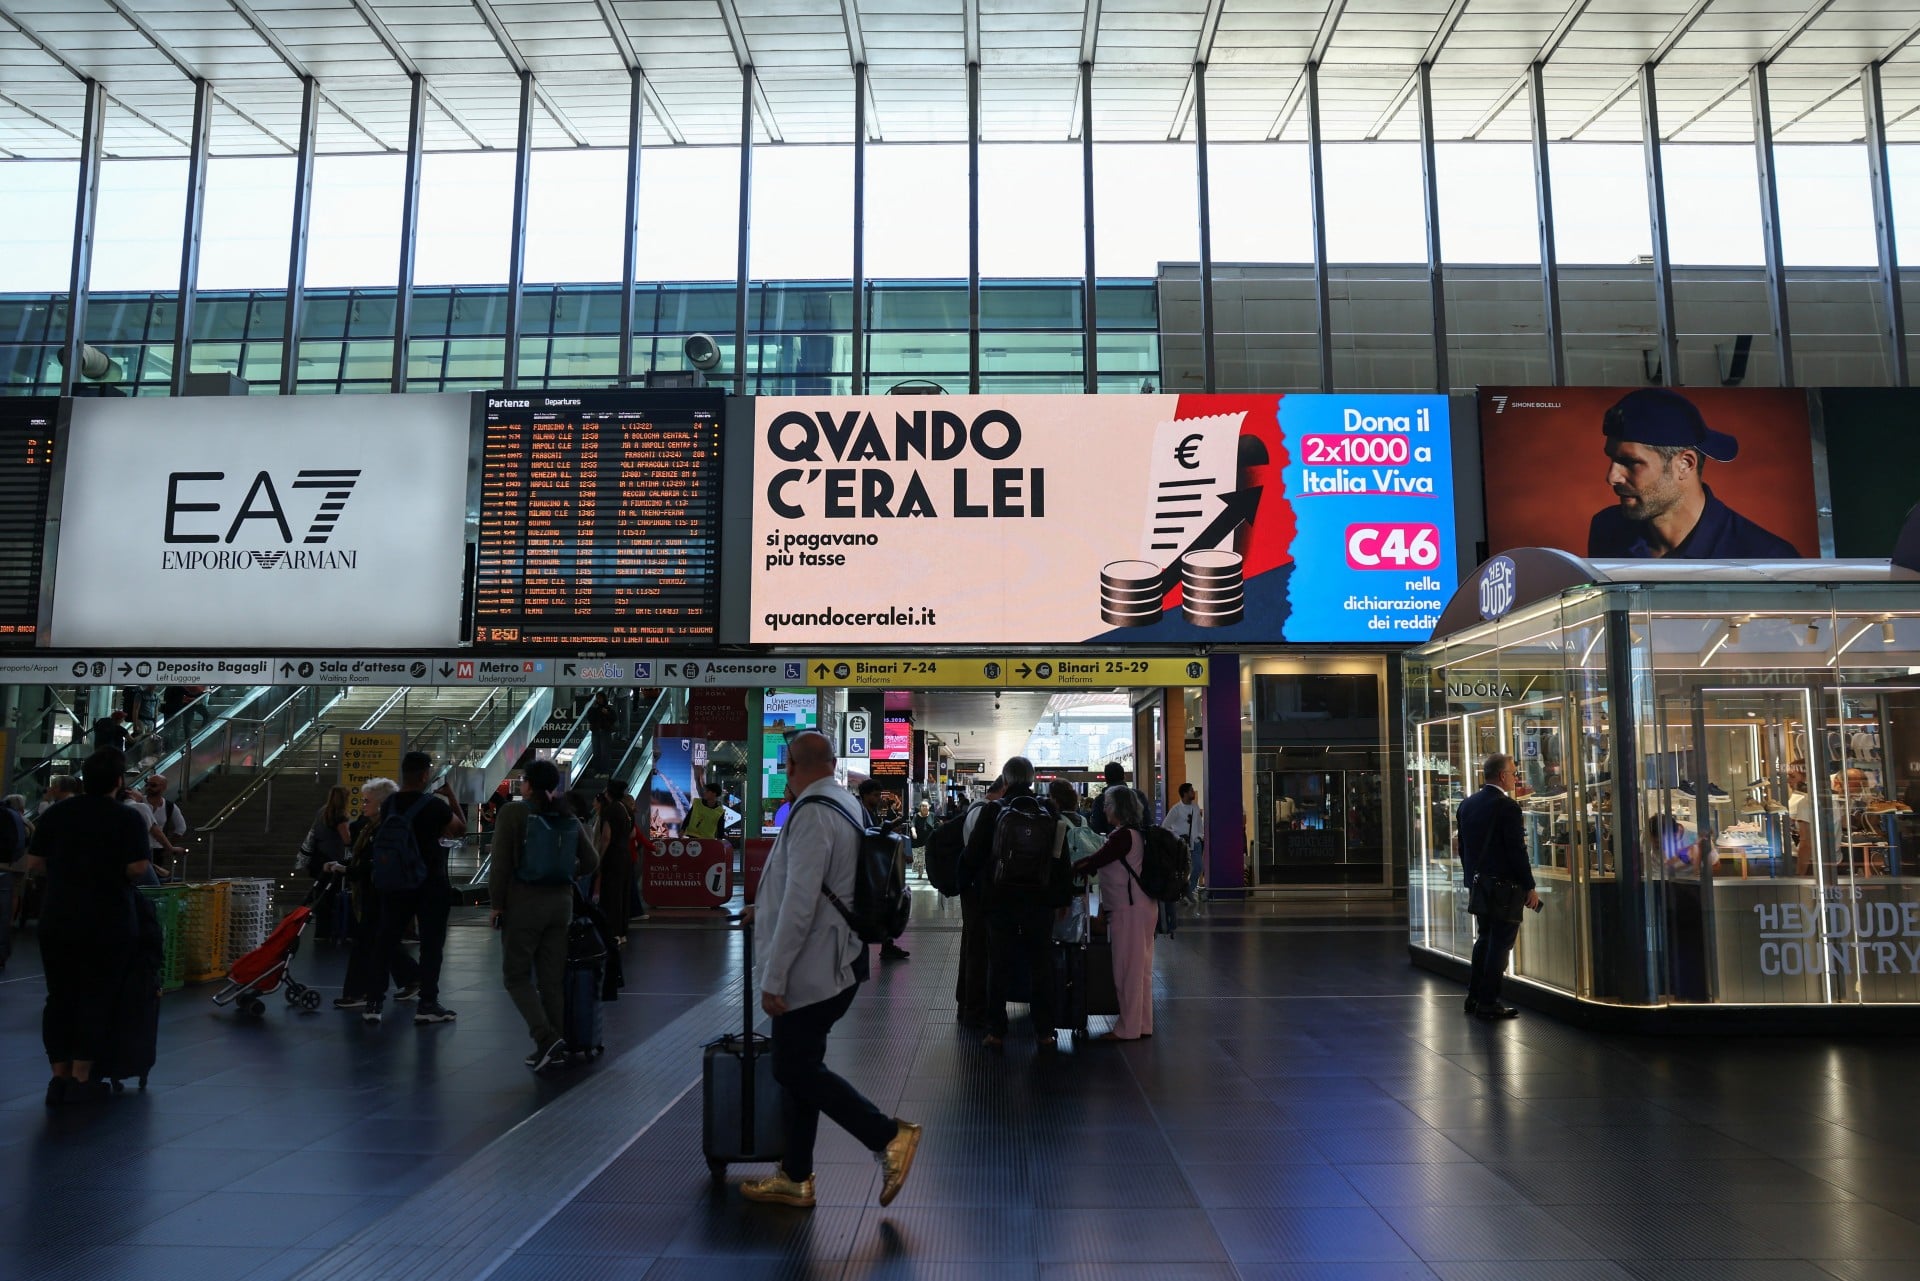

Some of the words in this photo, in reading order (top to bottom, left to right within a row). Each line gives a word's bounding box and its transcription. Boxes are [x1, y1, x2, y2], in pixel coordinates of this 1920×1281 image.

[489, 399, 530, 408] Partenze
[545, 398, 581, 406] Departures
[1344, 408, 1410, 432] Dona
[1417, 408, 1430, 432] il
[767, 410, 1022, 463] QVANDO
[1306, 438, 1408, 463] 2x1000
[1414, 445, 1432, 462] a
[1303, 469, 1367, 493] Italia
[1372, 469, 1433, 493] Viva
[767, 468, 938, 519] C'ERA
[953, 468, 1045, 518] LEI
[164, 470, 362, 544] EA7
[766, 529, 780, 546] si
[784, 532, 879, 550] pagavano
[1349, 528, 1437, 565] C46
[162, 551, 252, 569] EMPORIO
[279, 551, 357, 569] ARMANI
[766, 549, 794, 570] più
[798, 551, 846, 566] tasse
[1488, 561, 1506, 584] HEY
[1405, 576, 1440, 591] nella
[1481, 567, 1512, 615] DUDE
[1344, 597, 1441, 611] dichiarazione
[765, 606, 936, 631] quandoceralei.it
[1368, 615, 1390, 630] dei
[491, 628, 518, 640] 12:50
[157, 661, 213, 674] Deposito
[218, 661, 267, 674] Bagagli
[320, 661, 347, 672] Sala
[352, 661, 405, 672] d'attesa
[458, 663, 472, 676] M
[479, 662, 519, 673] Metro
[706, 662, 776, 673] Ascensore
[857, 662, 897, 673] Binari
[903, 662, 936, 673] 7-24
[1058, 662, 1099, 673] Binari
[1105, 662, 1149, 673] 25-29
[156, 673, 169, 681] Left
[171, 674, 200, 683] Luggage
[320, 674, 347, 683] Waiting
[479, 675, 527, 683] Underground
[705, 675, 715, 683] Lift
[857, 676, 890, 684] Platforms
[1058, 675, 1092, 683] Platforms
[772, 697, 815, 706] Unexpected
[350, 737, 380, 746] Uscite
[1760, 941, 1920, 975] COUNTRY
